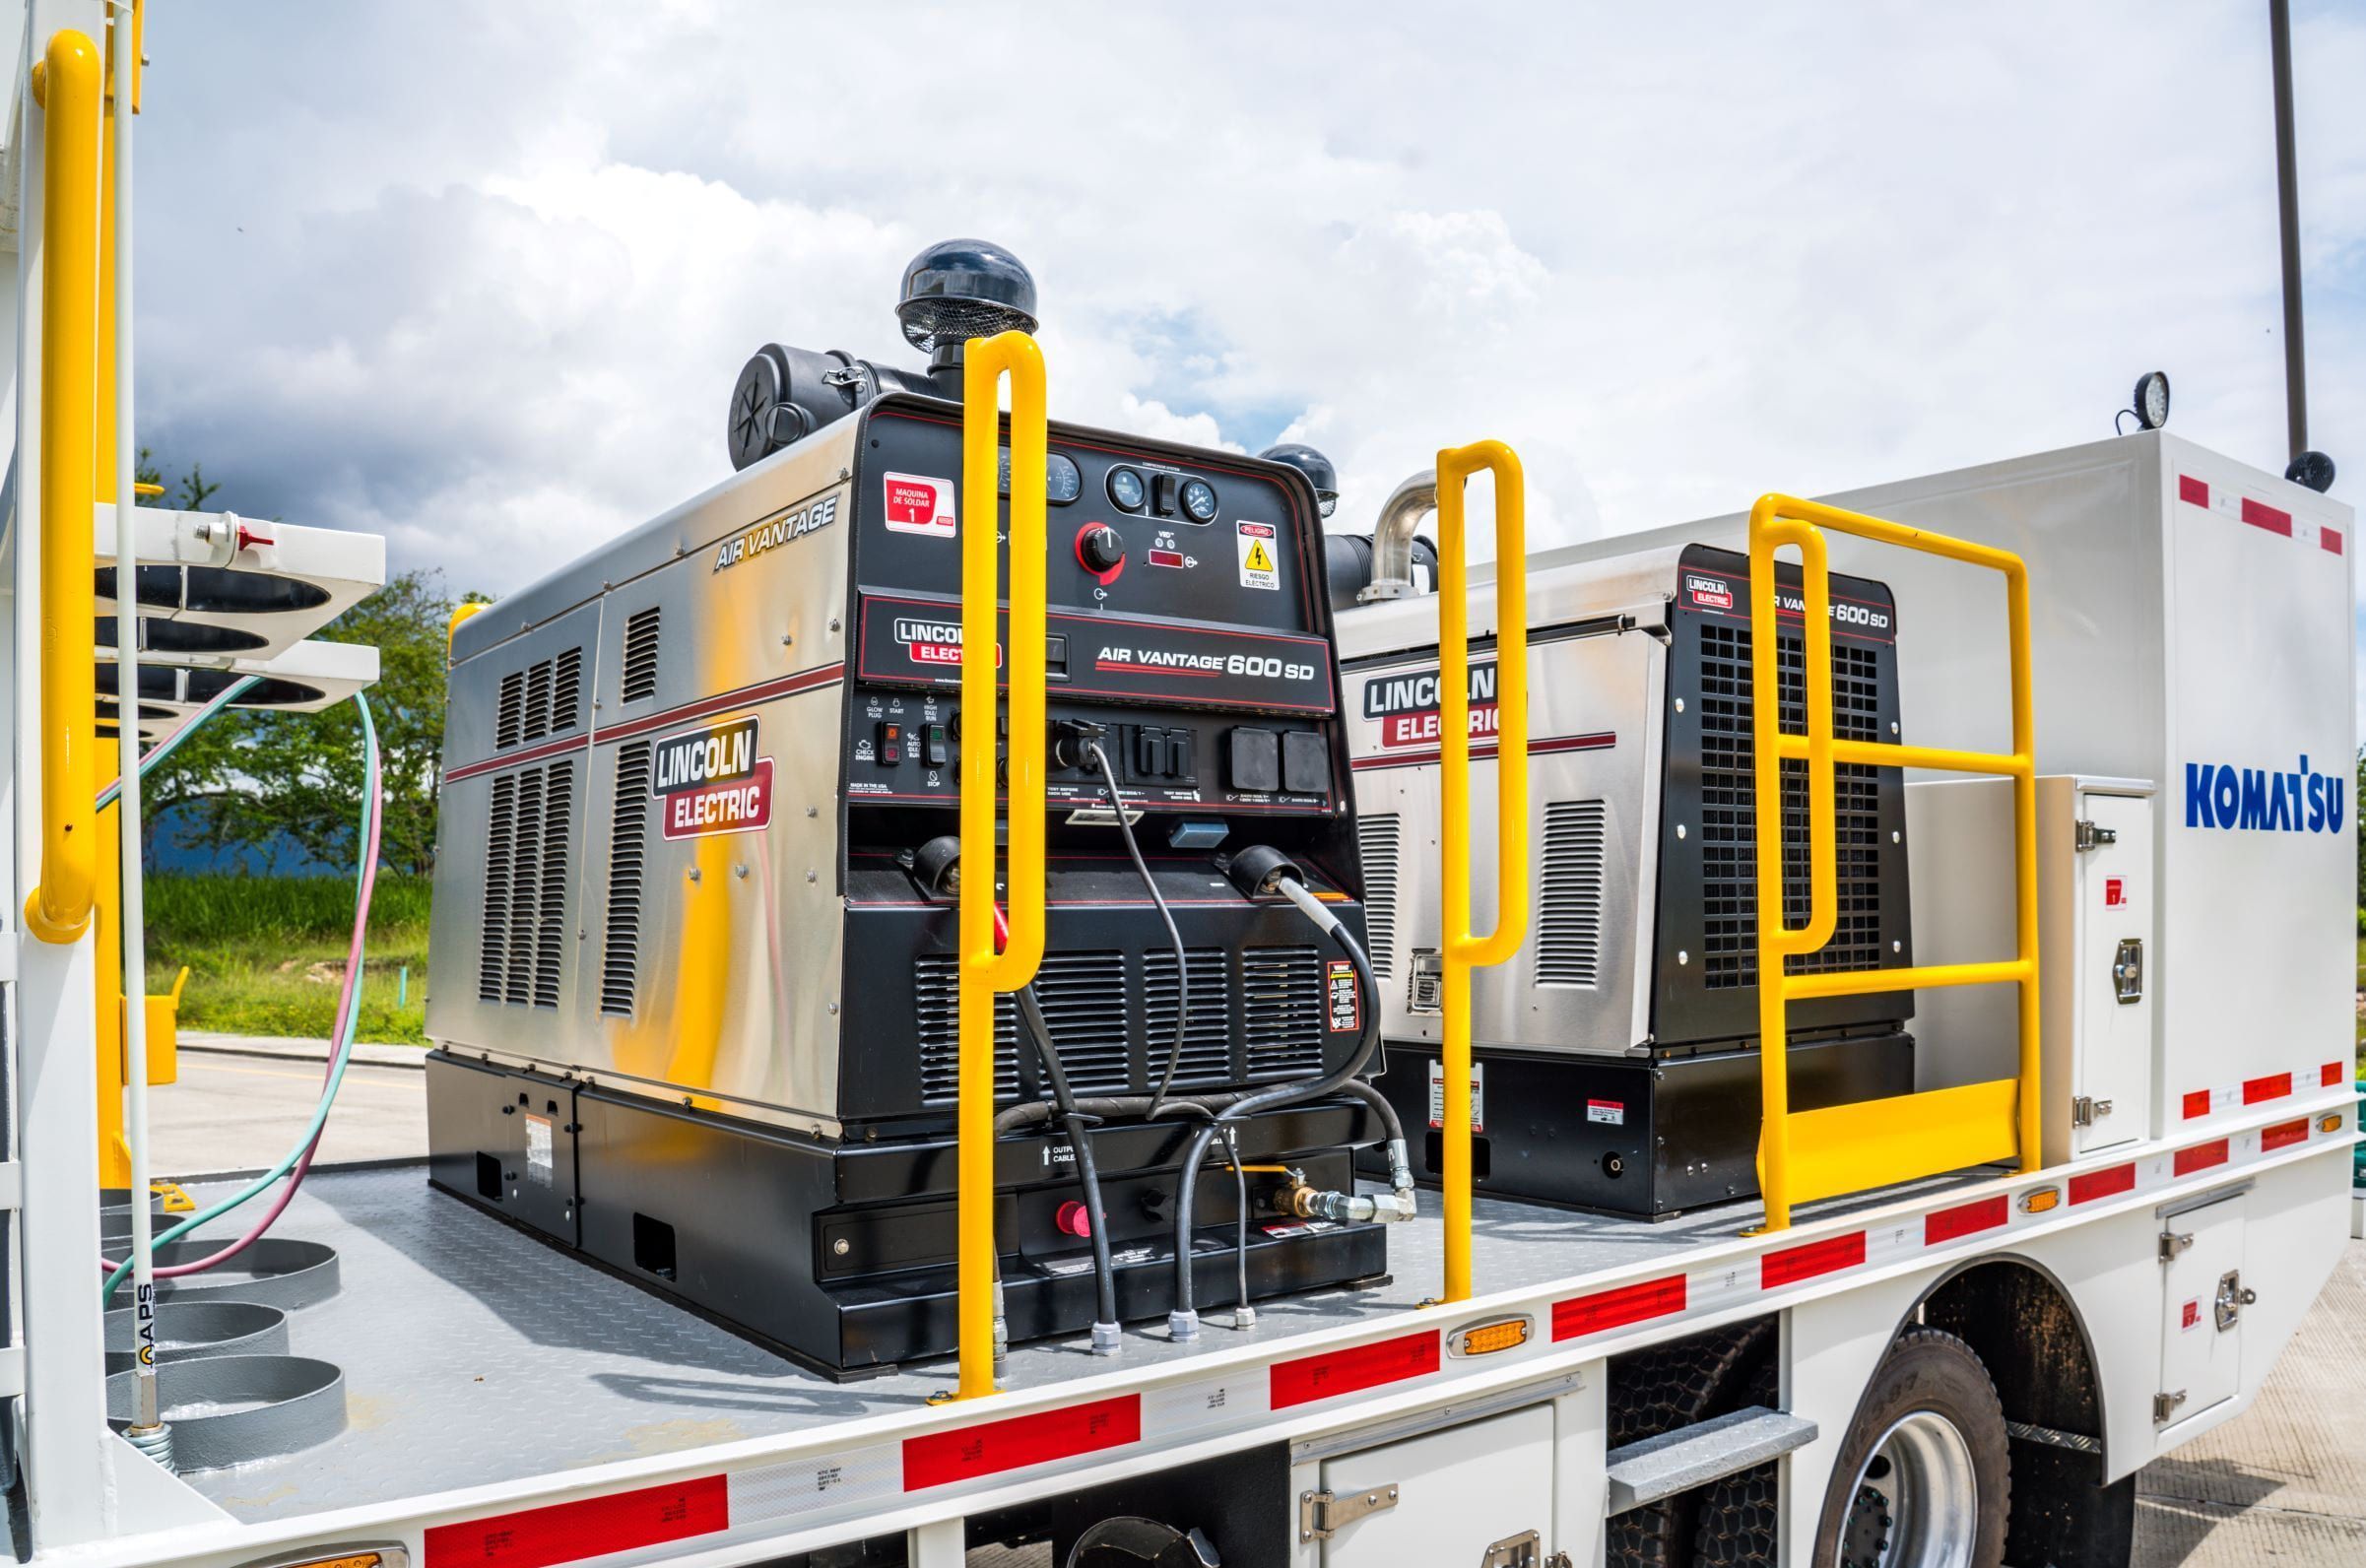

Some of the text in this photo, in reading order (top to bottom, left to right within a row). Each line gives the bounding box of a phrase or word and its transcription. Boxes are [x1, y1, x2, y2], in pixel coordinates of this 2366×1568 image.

[895, 489, 928, 498] MAQUINA
[904, 496, 930, 507] SOLDAR
[908, 508, 915, 522] 1
[715, 496, 837, 569] AIR VANTAGE
[1688, 578, 1724, 595] LINCOLN
[1697, 593, 1729, 606] ELECTRIC
[900, 622, 962, 644] LINCO
[921, 645, 962, 661] ELEC
[1097, 647, 1132, 662] AIR
[1137, 650, 1223, 670] VANTAGE
[1370, 668, 1494, 713] LINCN
[1397, 708, 1498, 741] ELERI
[657, 730, 753, 787] LINCOLN
[2186, 754, 2343, 834] KOMATSU
[674, 786, 759, 828] ELECTRIC
